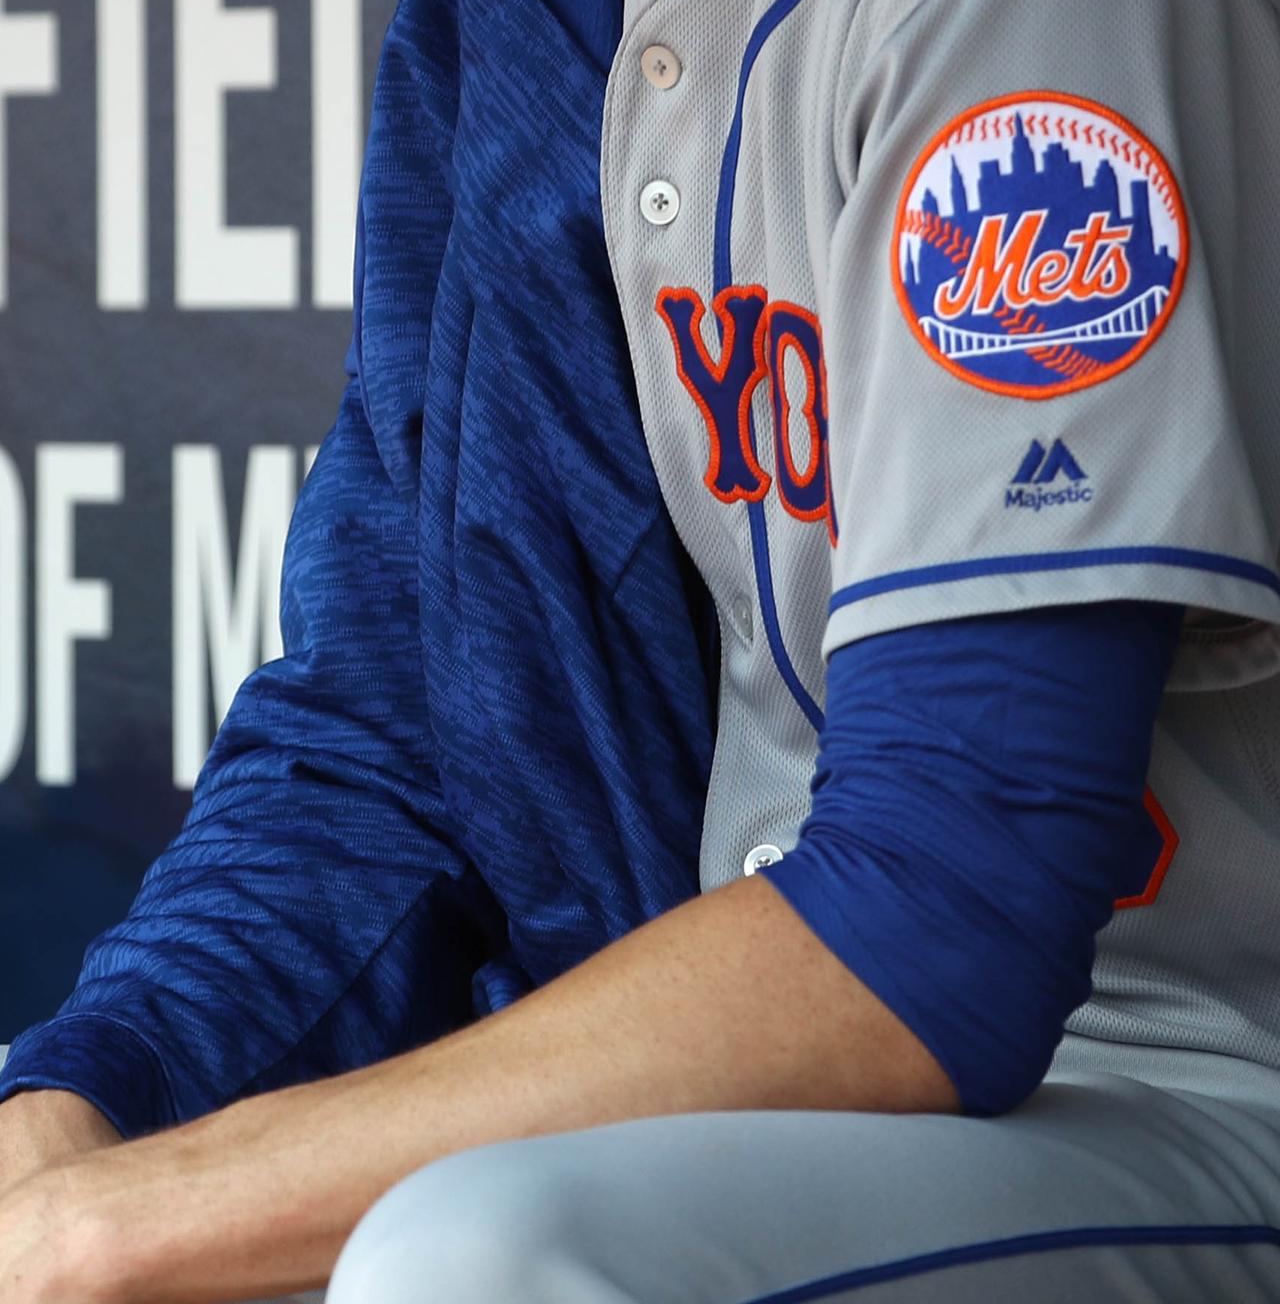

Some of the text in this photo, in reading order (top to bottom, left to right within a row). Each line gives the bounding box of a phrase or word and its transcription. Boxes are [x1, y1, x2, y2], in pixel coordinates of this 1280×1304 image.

[934, 208, 1134, 320] Mets
[655, 285, 839, 549] YO
[1004, 480, 1094, 512] Majestic
[172, 443, 320, 790] M
